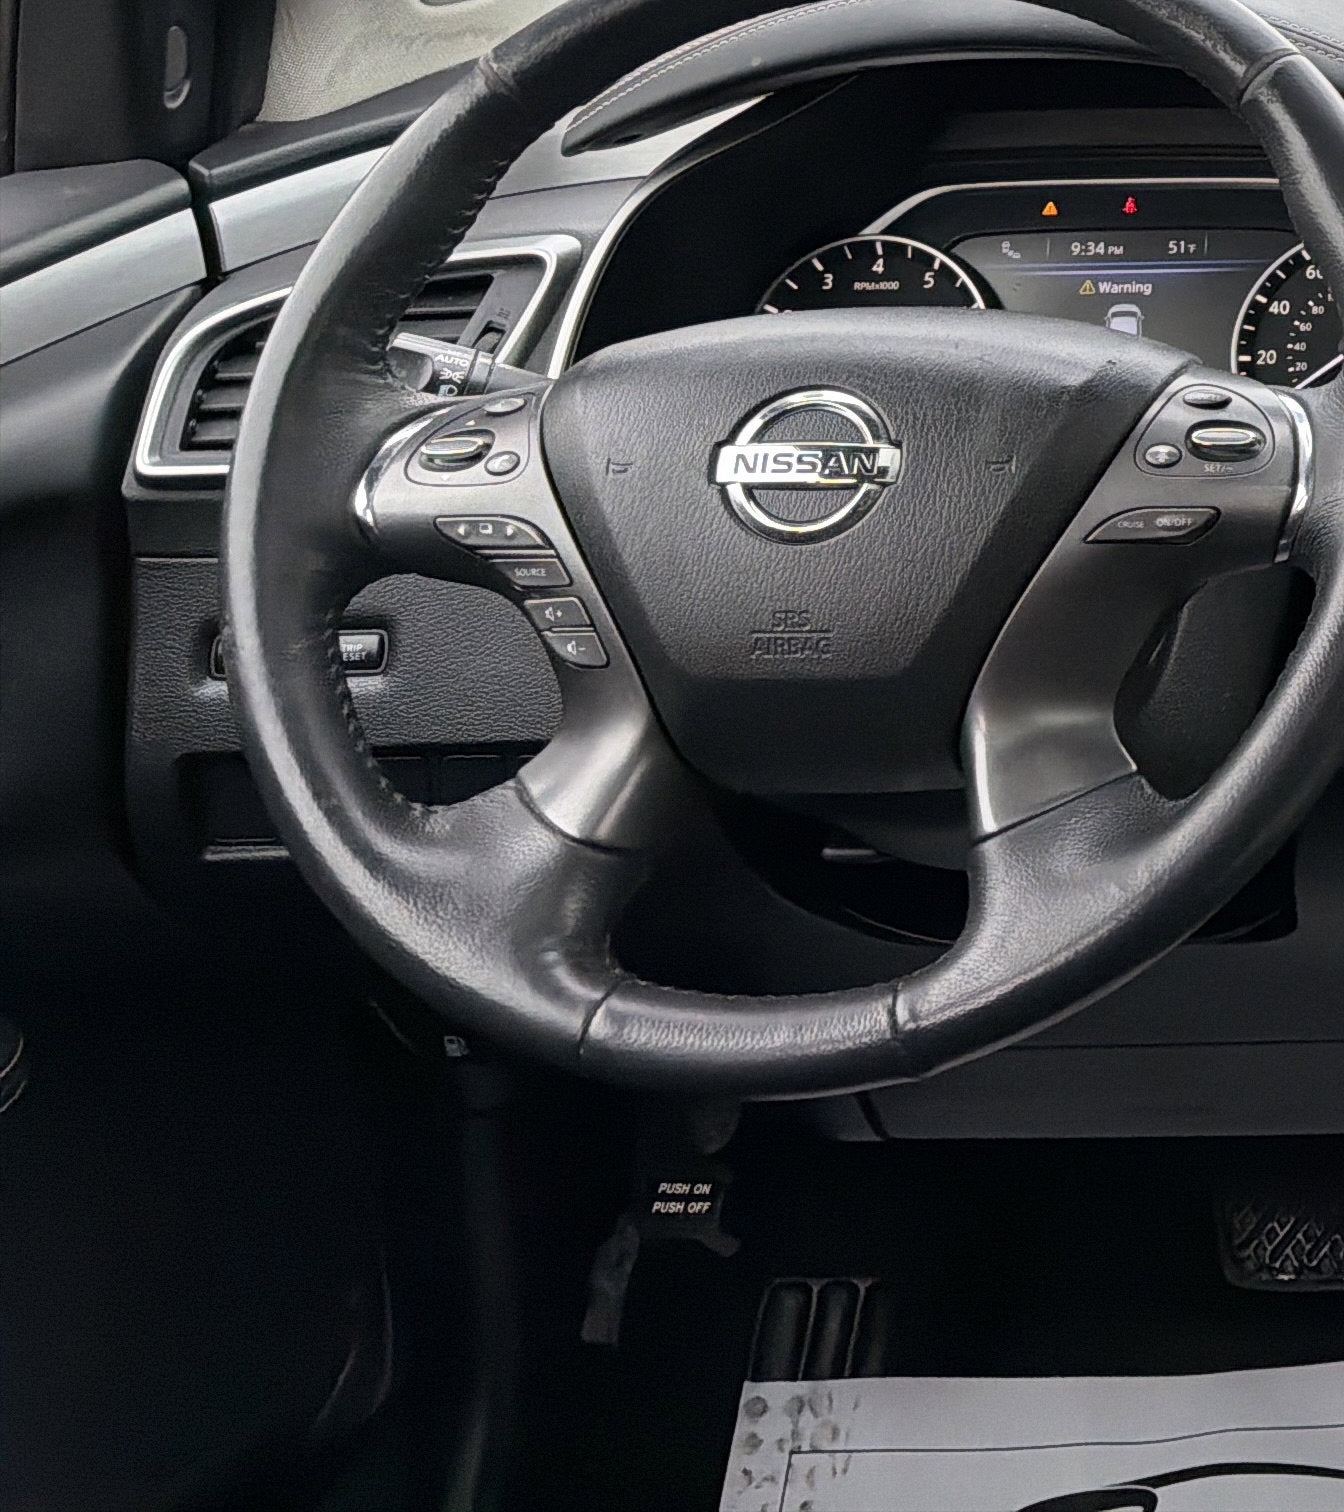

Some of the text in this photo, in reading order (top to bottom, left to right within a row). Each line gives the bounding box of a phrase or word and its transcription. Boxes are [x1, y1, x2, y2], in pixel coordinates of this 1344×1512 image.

[1071, 241, 1105, 255] 9:34
[871, 258, 885, 275] 4
[822, 274, 833, 289] 3
[922, 271, 935, 288] 5
[1098, 281, 1152, 296] Warning
[1269, 300, 1290, 314] 40
[1311, 306, 1324, 314] 80
[1299, 322, 1312, 332] 60
[1293, 342, 1306, 351] 40
[435, 354, 469, 367] AUTO
[1256, 349, 1277, 365] 20
[1295, 362, 1307, 371] 20
[733, 450, 879, 476] NISSAN
[513, 566, 547, 579] SOURCE
[770, 609, 812, 632] SRS
[342, 644, 363, 652] TRIP
[342, 652, 367, 661] ESET
[657, 1183, 712, 1195] PUSH ON
[652, 1202, 711, 1214] PUSH OFF
